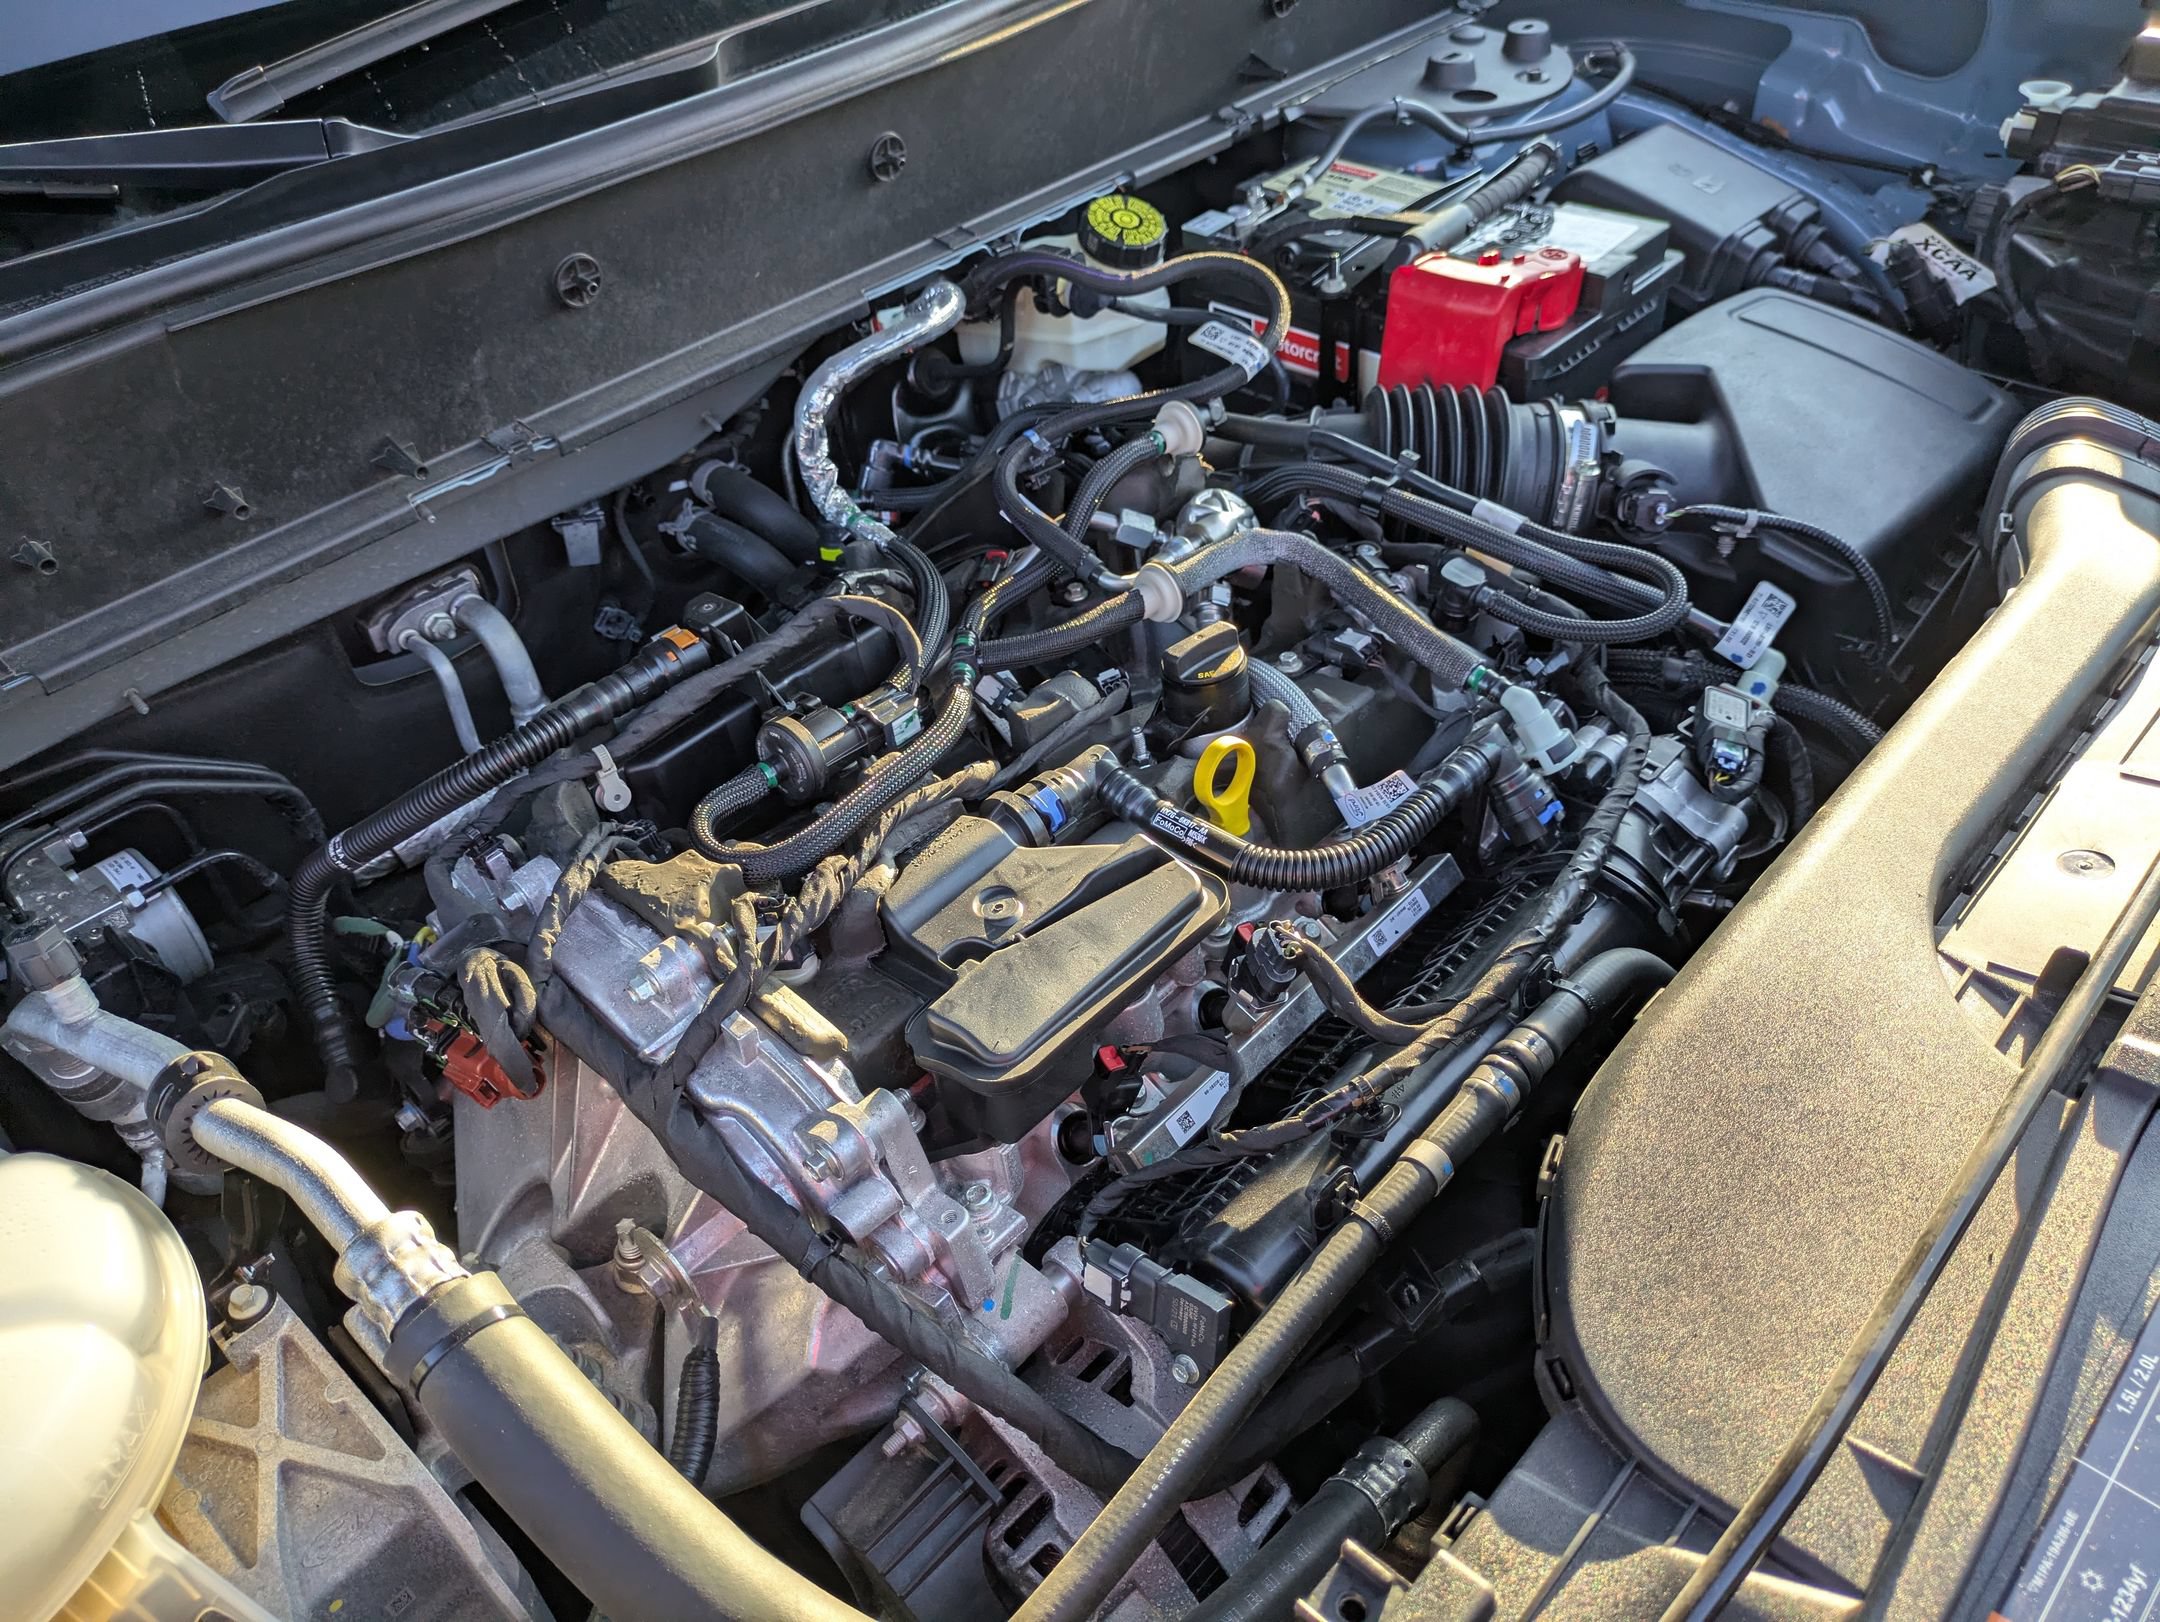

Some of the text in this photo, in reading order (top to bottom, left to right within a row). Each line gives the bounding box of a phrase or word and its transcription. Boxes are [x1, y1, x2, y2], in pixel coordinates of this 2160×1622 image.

[1155, 816, 1185, 836] FoMoCo
[2115, 1389, 2142, 1415] 1.5L
[2133, 1354, 2160, 1382] 2.0L
[2101, 1562, 2148, 1622] -1234yf
